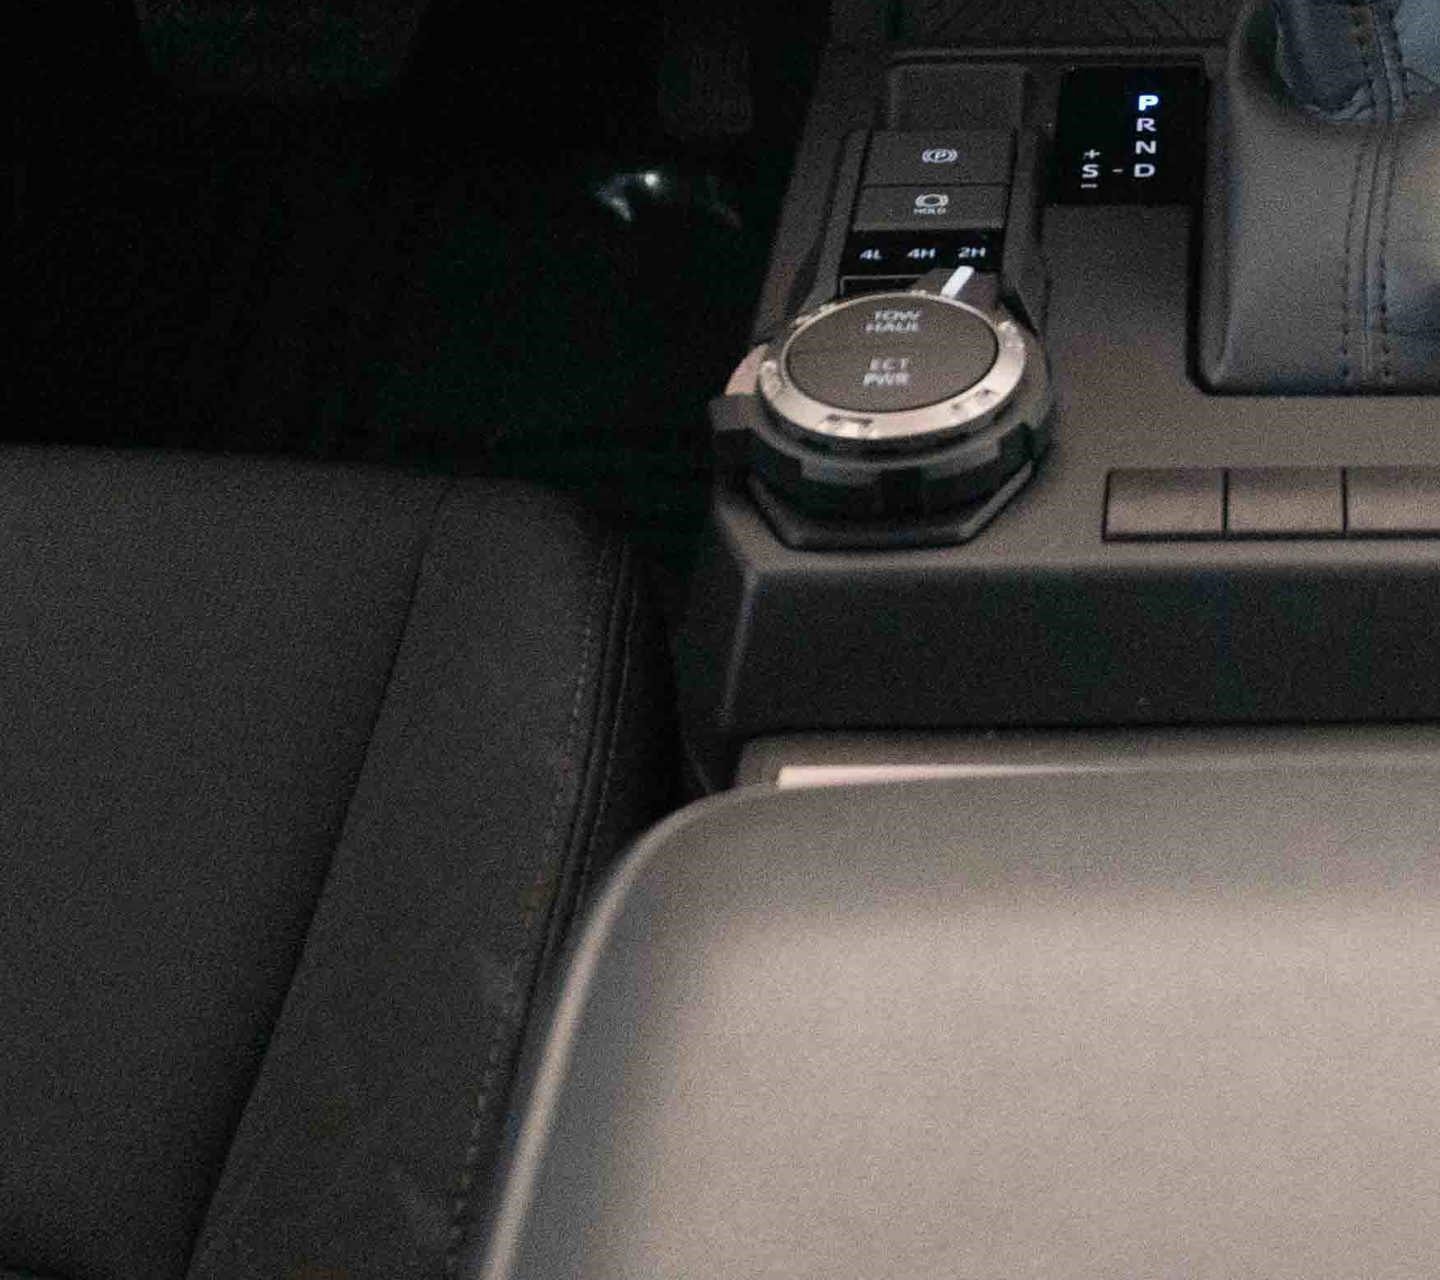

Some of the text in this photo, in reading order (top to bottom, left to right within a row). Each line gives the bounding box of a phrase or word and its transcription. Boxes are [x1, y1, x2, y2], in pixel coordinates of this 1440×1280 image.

[1138, 94, 1159, 111] P
[1136, 117, 1157, 132] R
[1135, 140, 1157, 155] N
[1133, 163, 1156, 178] D
[859, 246, 987, 260] 4L 4H 2H
